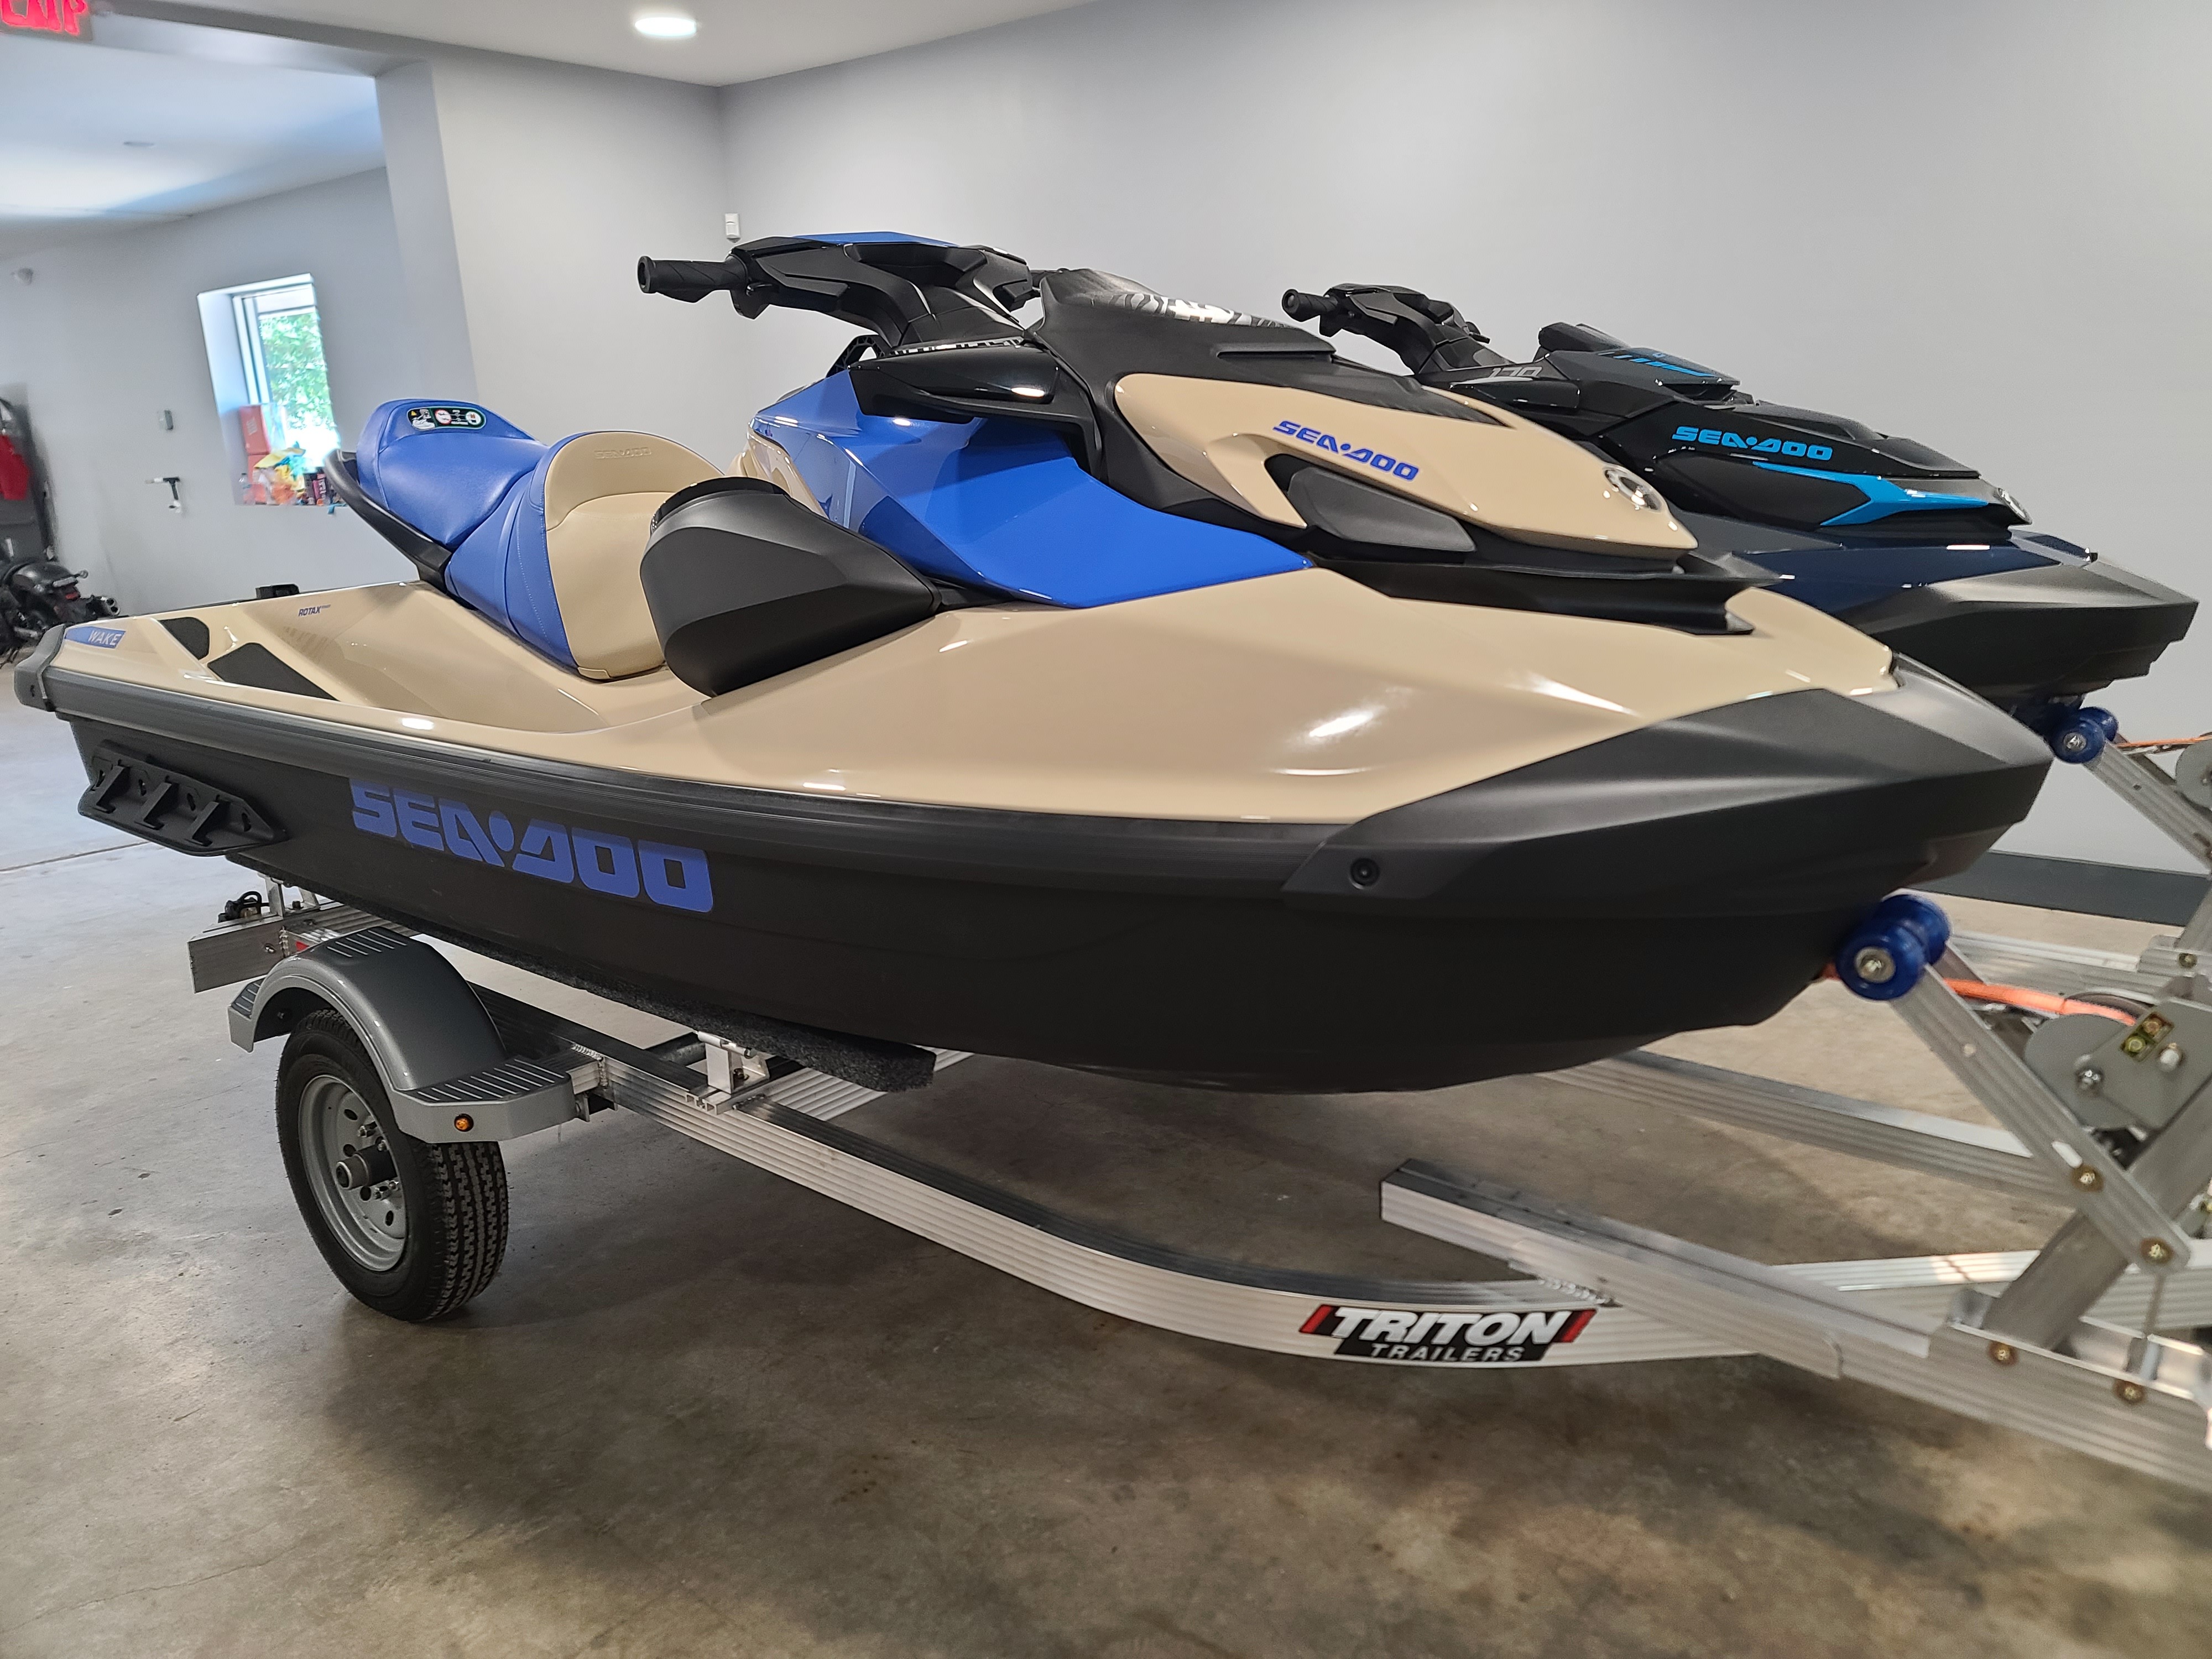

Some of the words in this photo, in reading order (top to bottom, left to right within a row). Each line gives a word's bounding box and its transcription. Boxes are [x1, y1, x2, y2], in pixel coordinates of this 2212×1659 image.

[1489, 367, 1542, 378] 170
[299, 606, 321, 617] ROTAX
[88, 630, 122, 646] WAKE
[1331, 1307, 1573, 1346] TRITON
[1370, 1342, 1525, 1363] TRAILERS
